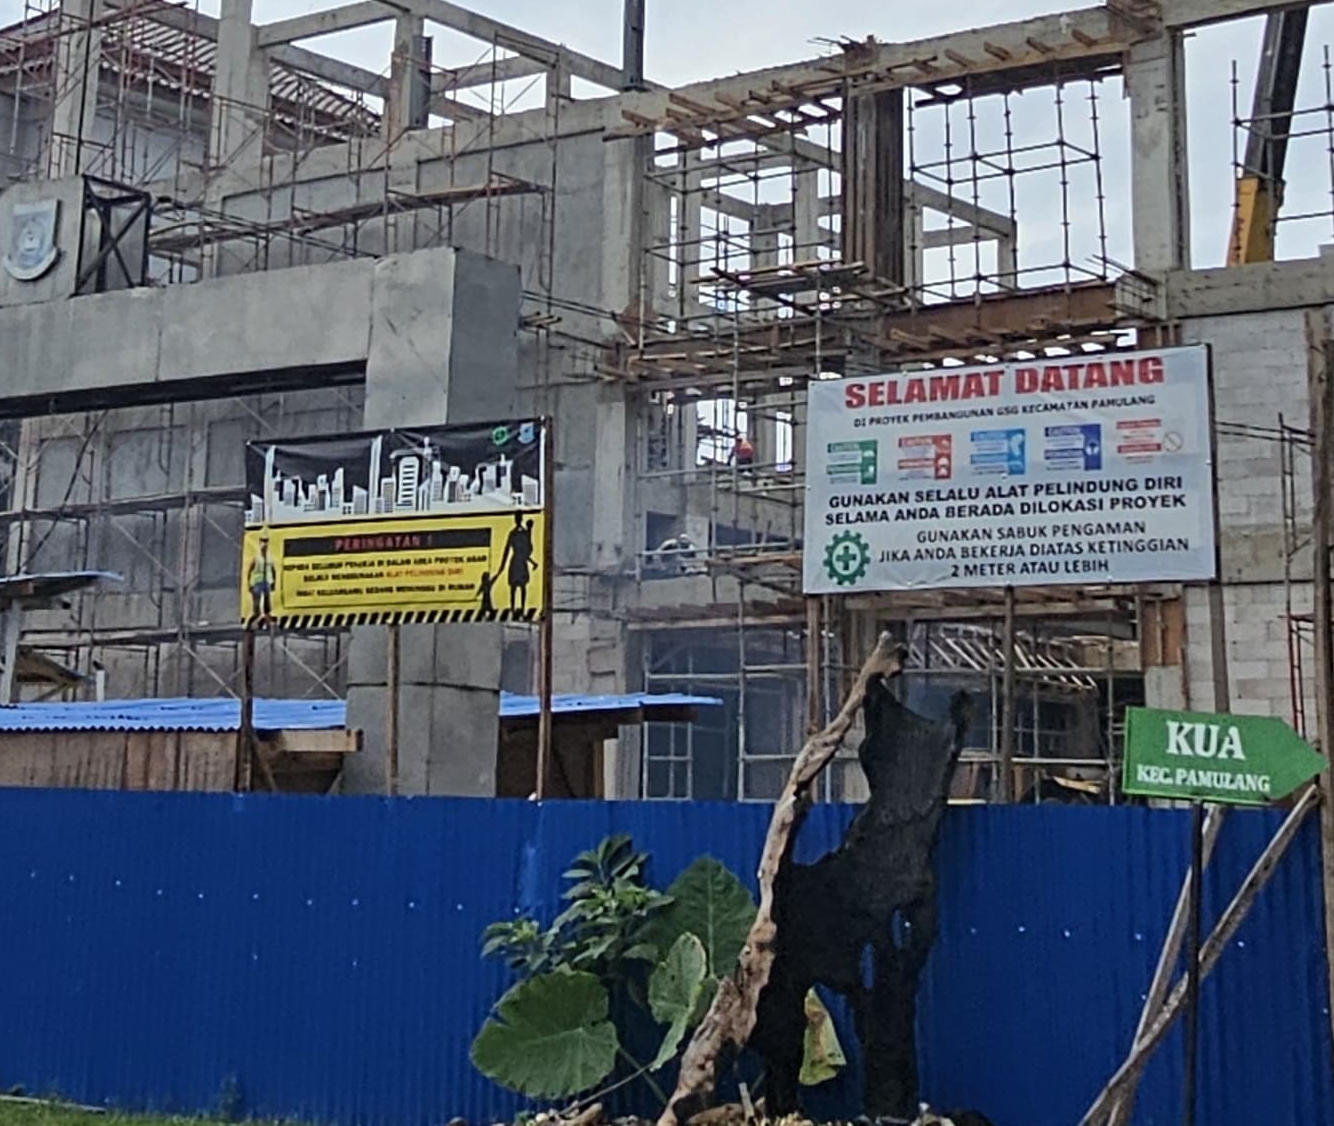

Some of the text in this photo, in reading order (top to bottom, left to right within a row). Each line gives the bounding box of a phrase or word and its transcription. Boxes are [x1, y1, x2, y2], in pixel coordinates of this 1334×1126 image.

[845, 356, 1164, 409] SELAMAT DATANG
[854, 418, 866, 428] DI
[869, 414, 909, 426] PROYEK
[912, 408, 994, 423] PEMBANGUNAN
[1022, 401, 1088, 414] KECAMATAN
[1091, 395, 1156, 408] PAMULANG
[829, 475, 1183, 509] GUNAKAN SELALU ALAT PELINDUNG DIRI
[825, 494, 1186, 525] SELAMA ANDA BERADA DILOKASI PROYEK
[335, 535, 420, 551] PERINGATAN
[917, 521, 1146, 543] GUNAKAN SABUK PENGAMAN
[879, 538, 1189, 563] JIKA ANDA BEKERJA DIATAS KETINGGIAN
[950, 559, 1109, 578] 2 METER ATAU LEBIH
[1166, 720, 1246, 761] KUA
[1176, 768, 1271, 793] PAMULANG
